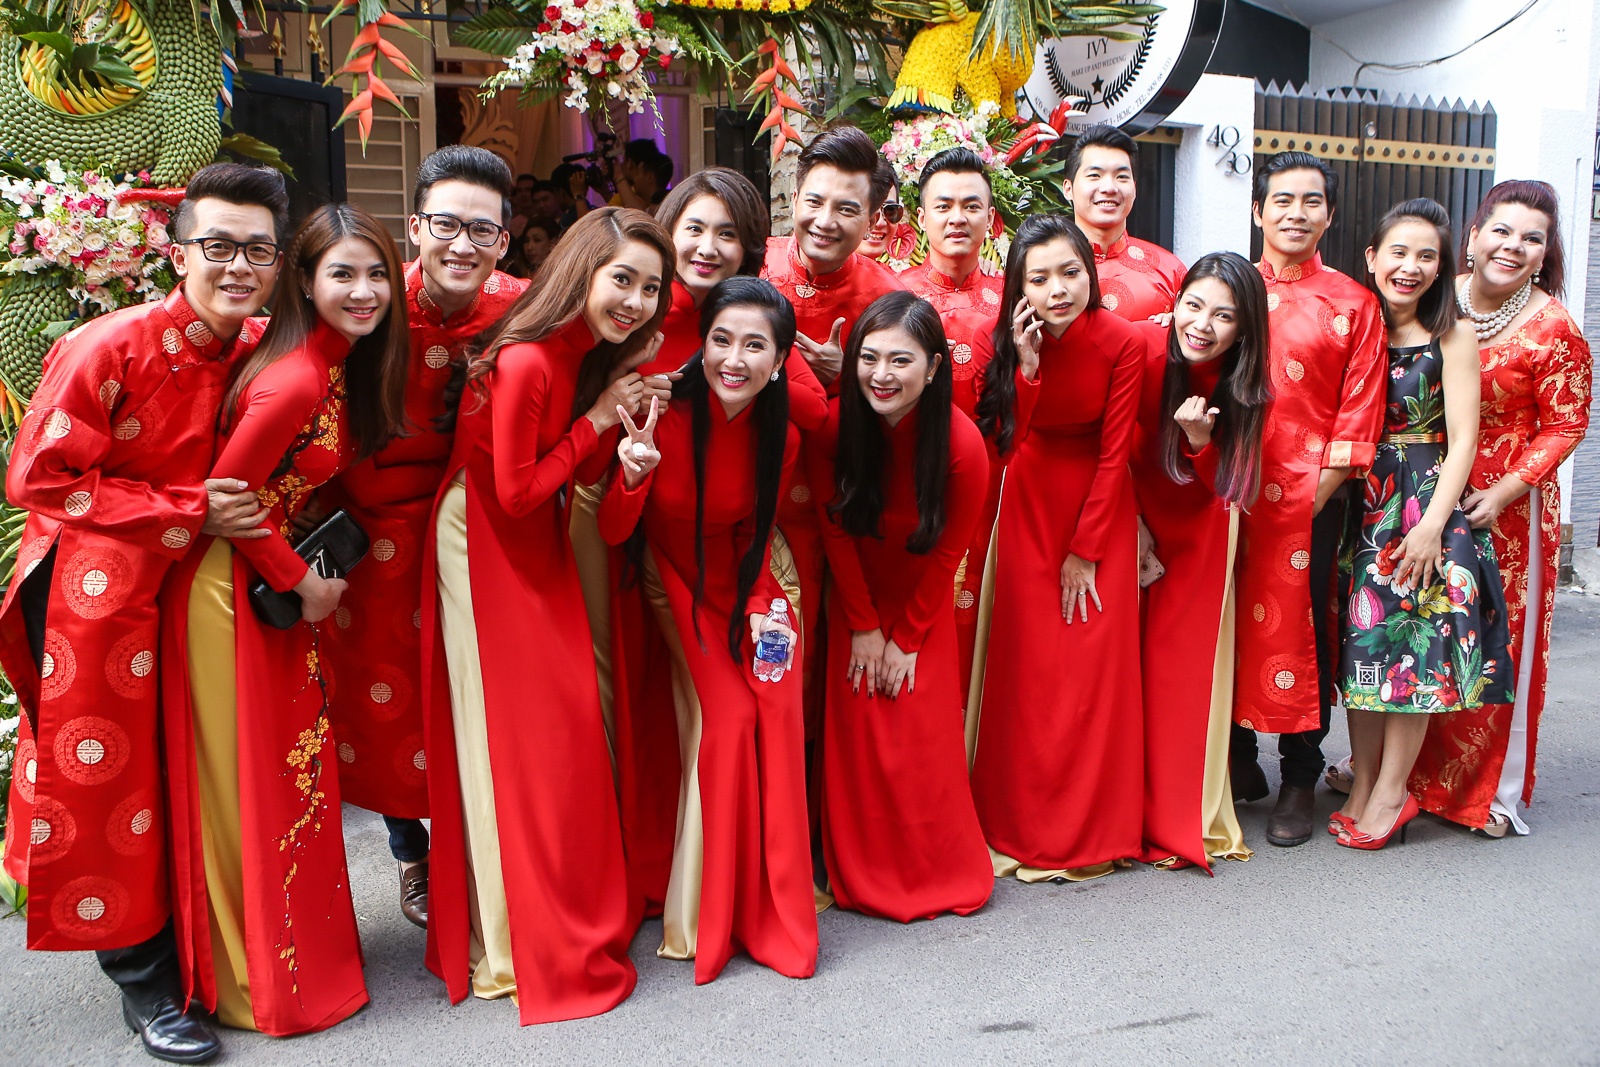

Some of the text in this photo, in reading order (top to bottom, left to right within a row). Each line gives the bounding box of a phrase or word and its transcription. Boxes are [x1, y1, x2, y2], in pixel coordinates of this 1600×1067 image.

[1087, 37, 1109, 59] IVY
[1071, 67, 1084, 77] MAKE
[1091, 61, 1102, 71] AND
[1102, 54, 1127, 68] WEDDING
